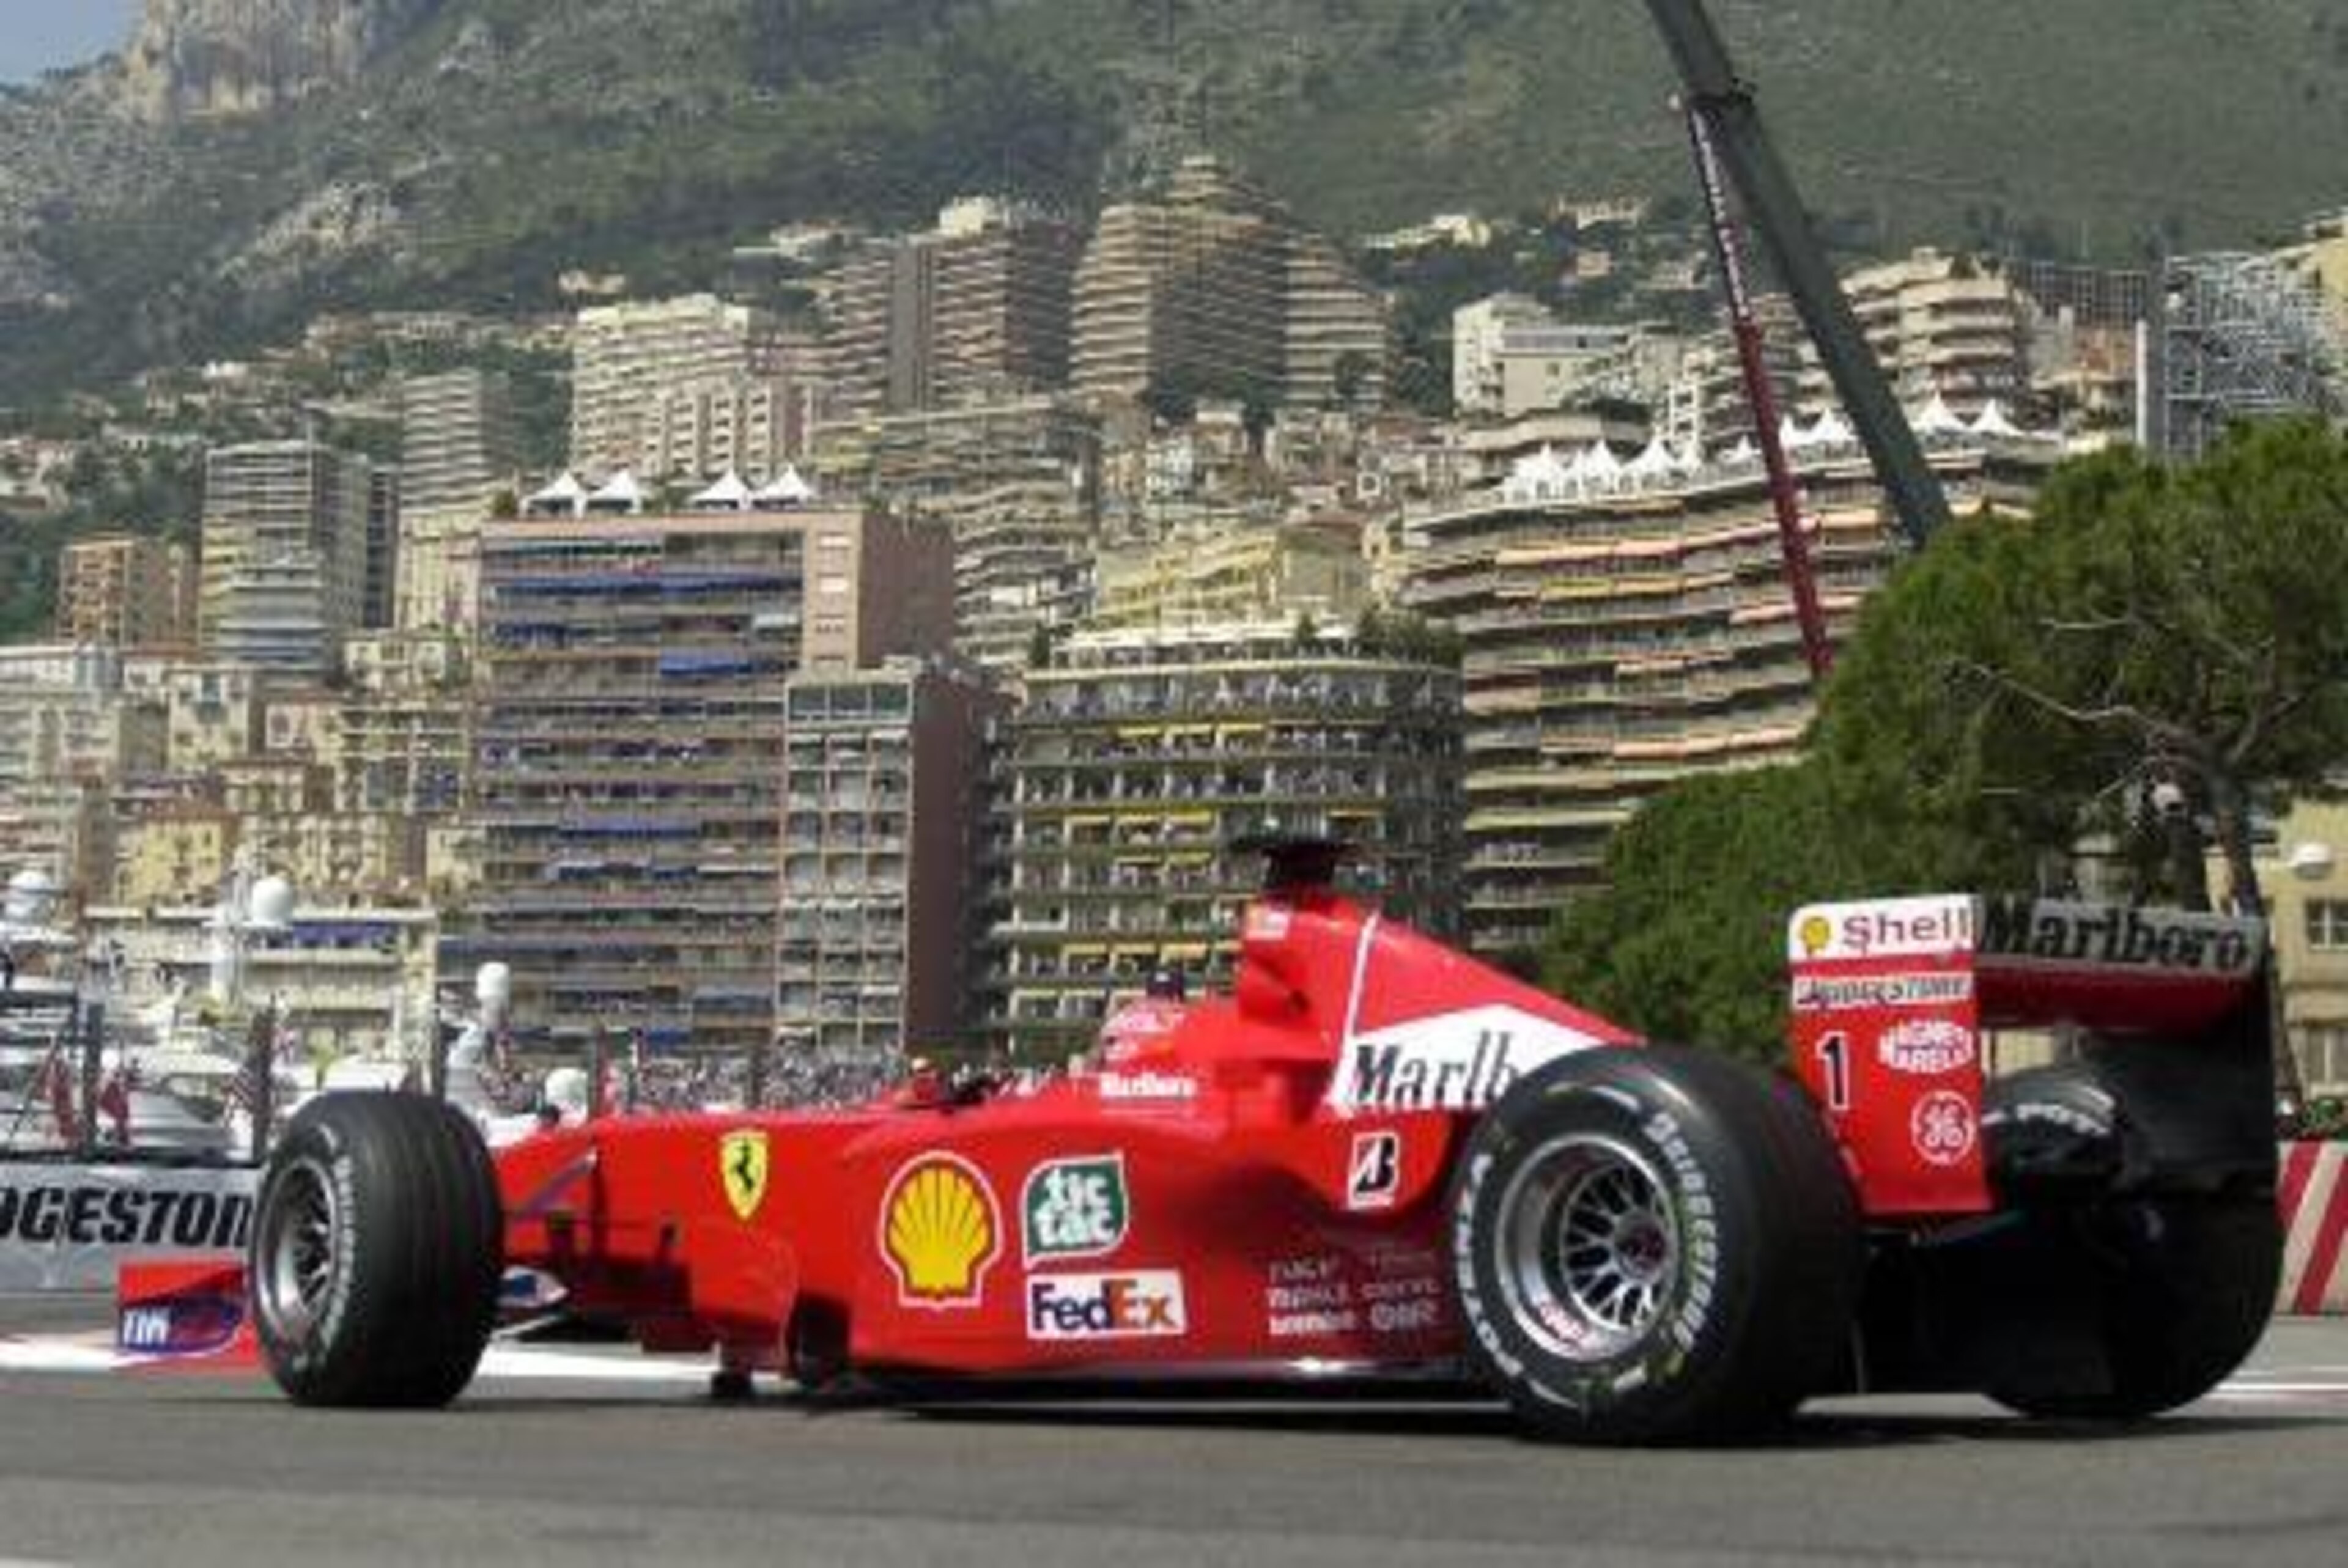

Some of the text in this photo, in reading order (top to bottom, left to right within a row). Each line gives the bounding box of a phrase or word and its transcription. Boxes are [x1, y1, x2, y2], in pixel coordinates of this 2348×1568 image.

[1842, 907, 1969, 948] Shell
[1982, 900, 2246, 971] Marlboro
[1817, 1031, 1848, 1108] 1
[1043, 1168, 1110, 1213] tic
[1032, 1279, 1177, 1331] FedEx
